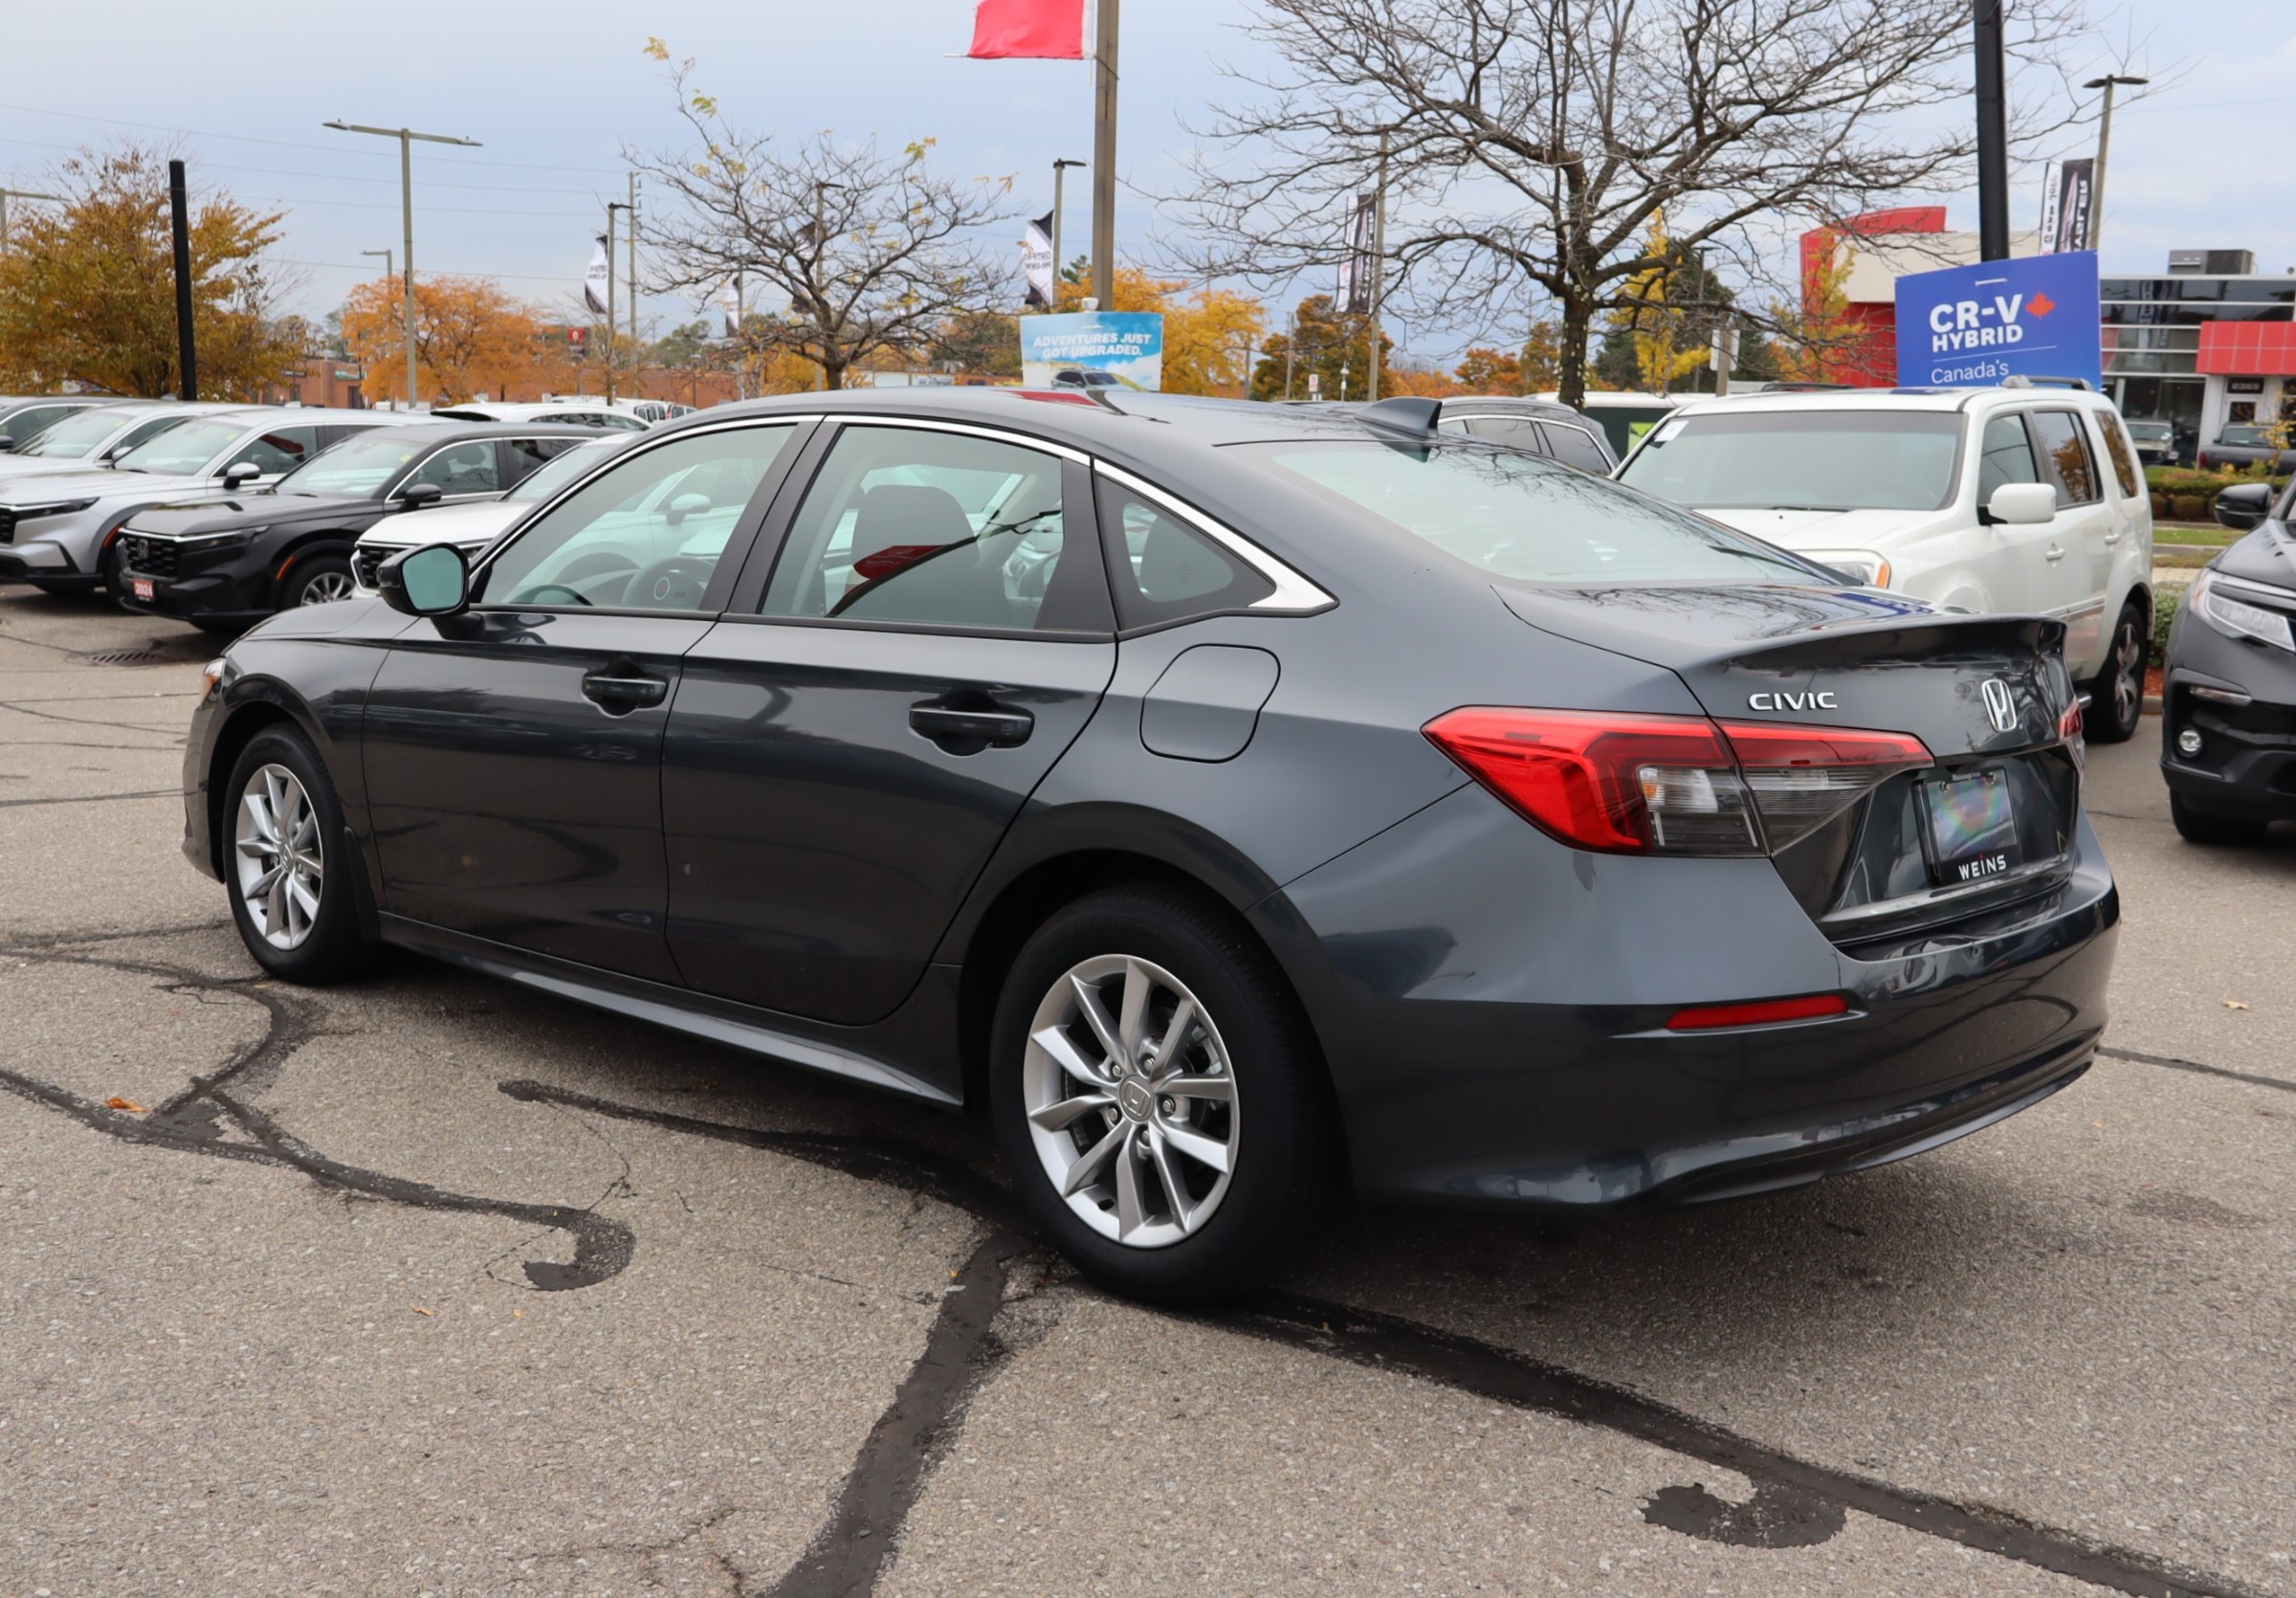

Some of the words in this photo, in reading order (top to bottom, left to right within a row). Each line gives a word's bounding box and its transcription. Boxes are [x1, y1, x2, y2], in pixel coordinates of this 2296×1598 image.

[1929, 294, 2023, 333] CR-V
[1034, 332, 1118, 346] ADVENTURES
[1120, 333, 1151, 344] JUST
[1042, 346, 1069, 358] GOT
[1071, 344, 1142, 357] UPGRADED.
[1932, 324, 2023, 353] HYBRID
[1931, 359, 2010, 385] Canada's
[1749, 692, 1839, 711] CIVIC
[1958, 854, 2007, 880] WEINS
